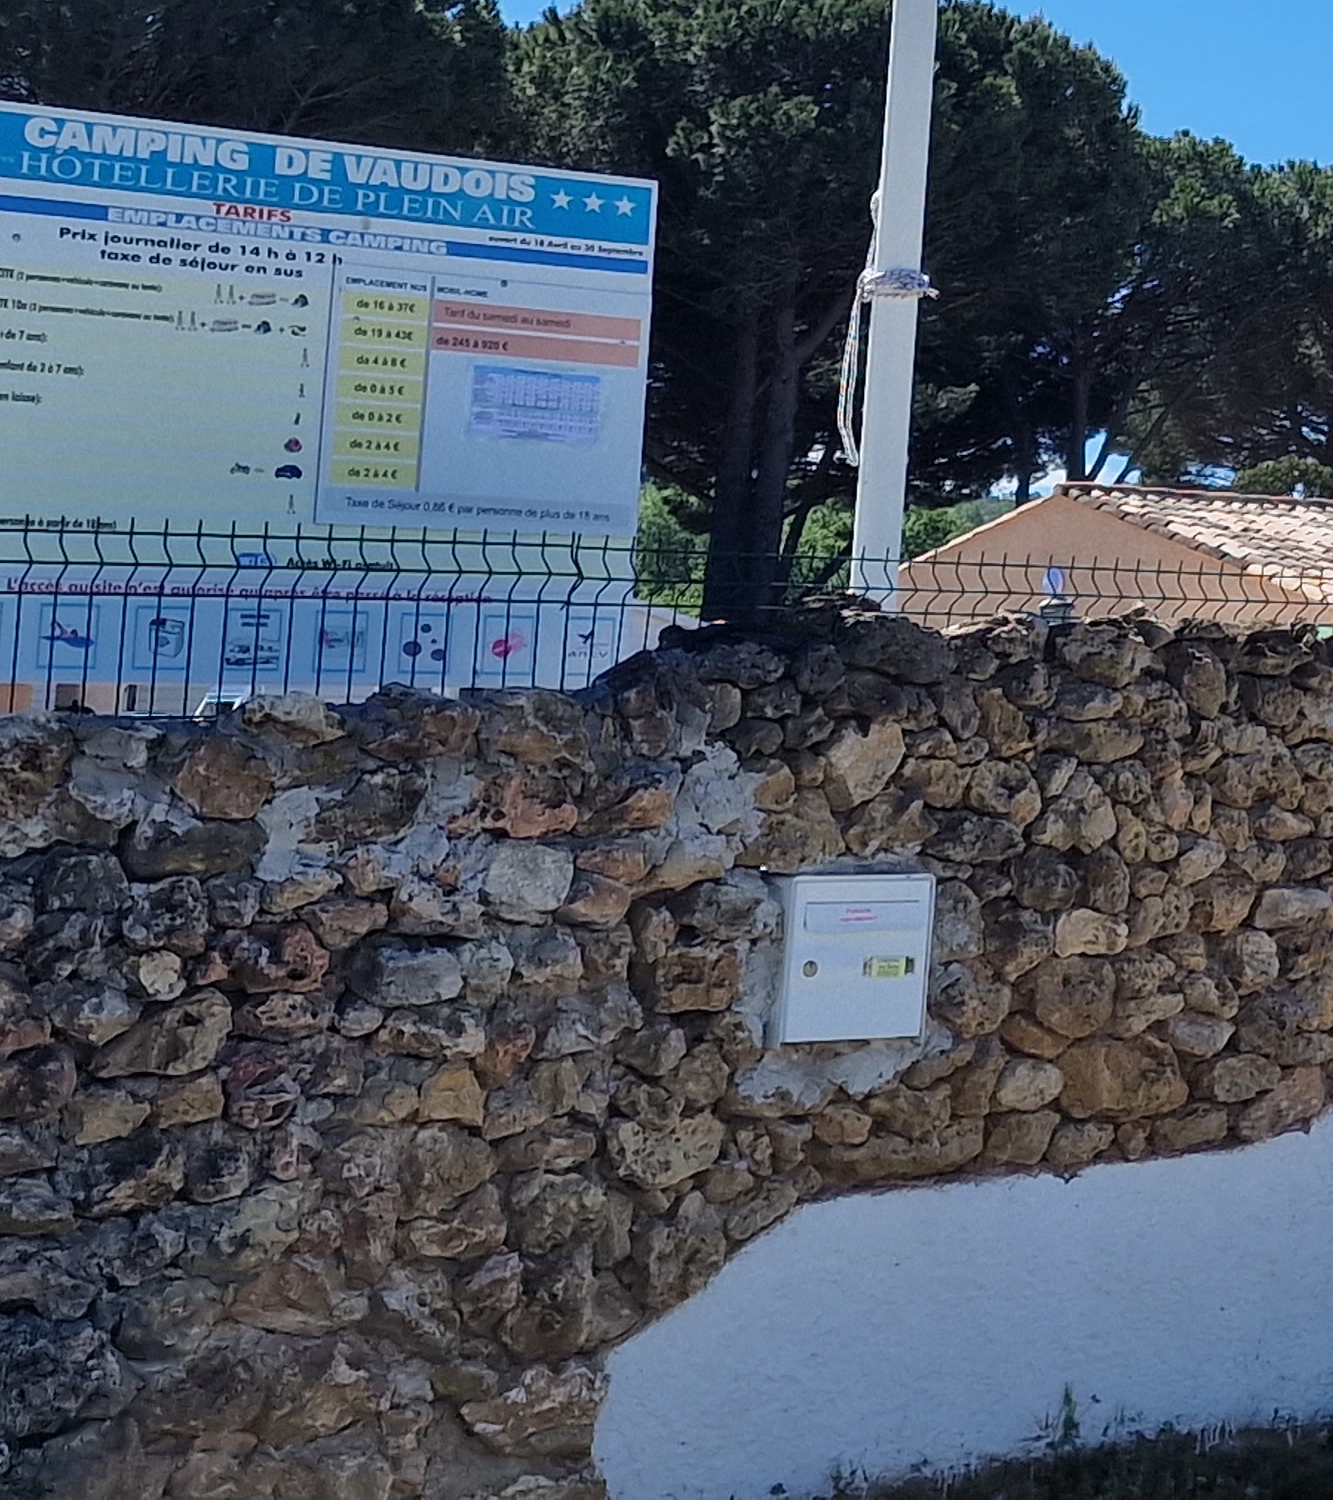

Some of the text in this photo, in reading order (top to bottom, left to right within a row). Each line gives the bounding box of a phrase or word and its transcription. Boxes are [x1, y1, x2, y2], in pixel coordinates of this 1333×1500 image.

[24, 116, 537, 203] CAMPING DE VAUDOIS
[212, 202, 292, 223] TARIFS
[293, 181, 344, 210] DE
[356, 187, 464, 222] PLEIN
[471, 206, 537, 230] AIR
[107, 206, 448, 255] EMPLACEMENTS CAMPING
[58, 226, 98, 242] Prix
[103, 230, 202, 252] journalier
[208, 239, 231, 255] de
[239, 244, 262, 257] 14
[267, 246, 280, 260] h
[285, 247, 297, 261] à
[305, 251, 326, 264] 12
[99, 249, 304, 278] taxe de séjour en sus
[444, 306, 466, 318] Tarif
[467, 309, 480, 320] du
[436, 336, 449, 346] de
[502, 341, 509, 351] €
[399, 358, 407, 369] €
[397, 386, 405, 396] €
[395, 414, 402, 424] €
[393, 442, 400, 452] €
[390, 470, 398, 480] €
